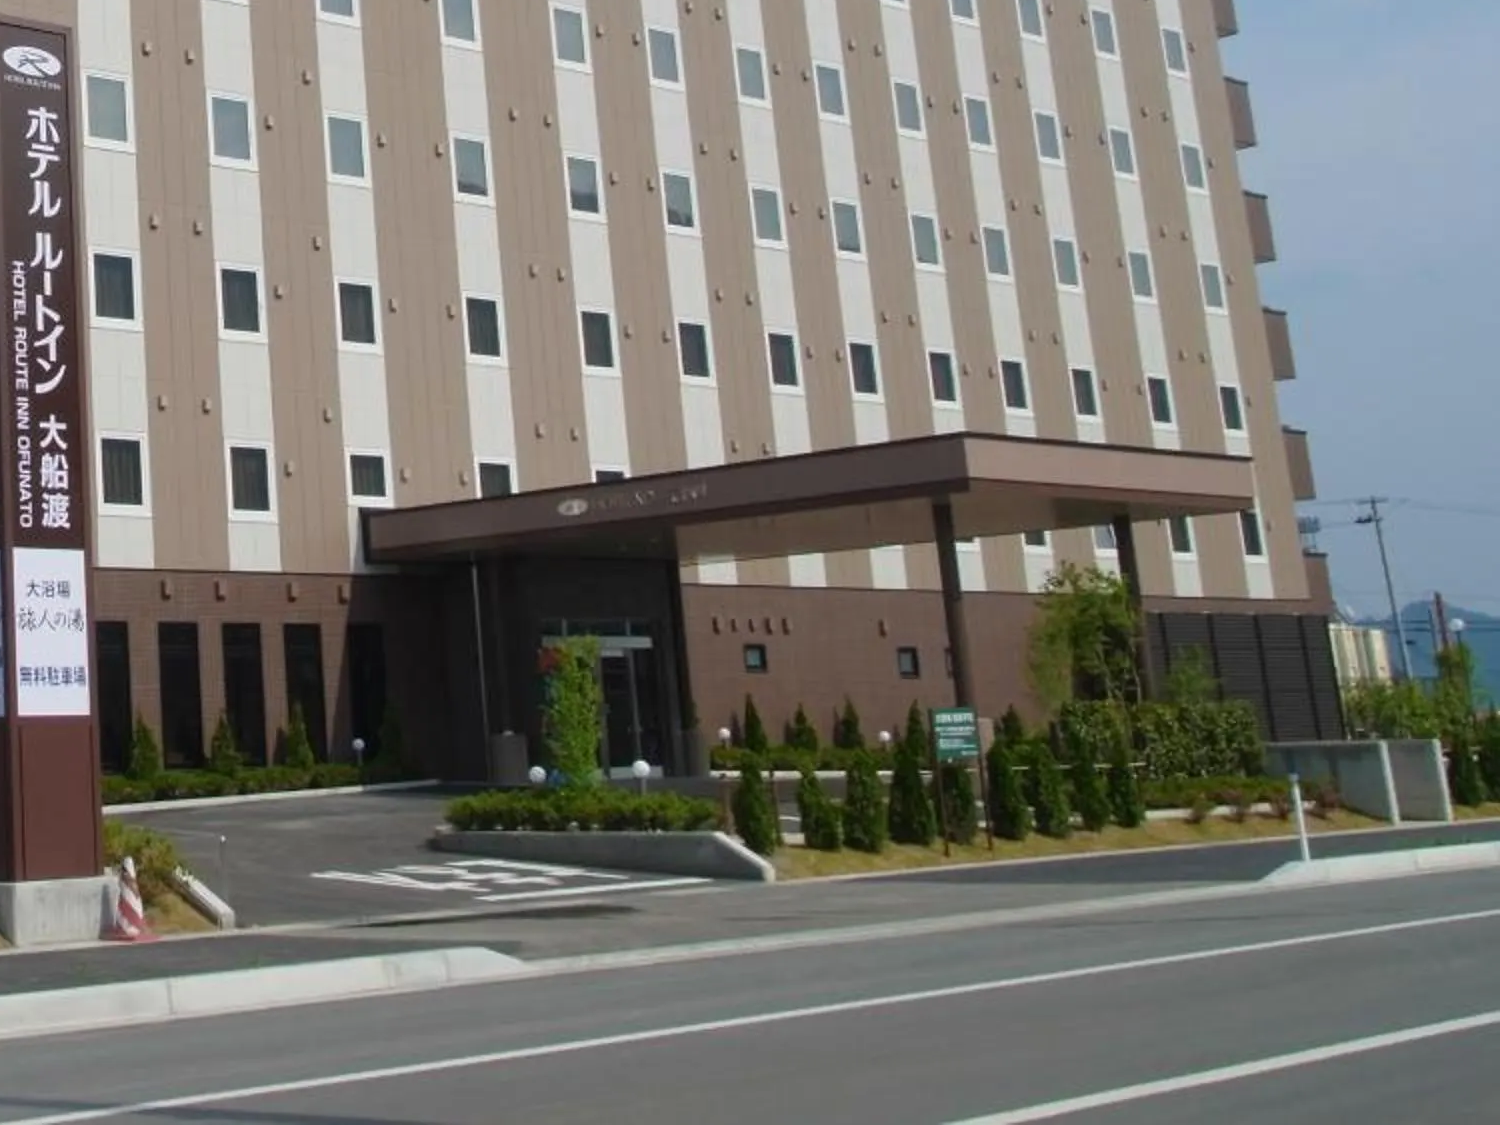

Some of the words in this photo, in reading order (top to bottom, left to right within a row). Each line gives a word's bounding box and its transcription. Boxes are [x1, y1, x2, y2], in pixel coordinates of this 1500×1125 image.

[25, 106, 62, 218] ホテル
[11, 260, 27, 321] HOTEL
[30, 231, 67, 394] ルートイン
[14, 327, 29, 391] ROUTE
[15, 396, 30, 430] INN
[17, 436, 33, 528] OFUNATO
[39, 413, 71, 530] 大船渡
[26, 579, 71, 598] 大浴場
[19, 666, 86, 687] 無料駐車場
